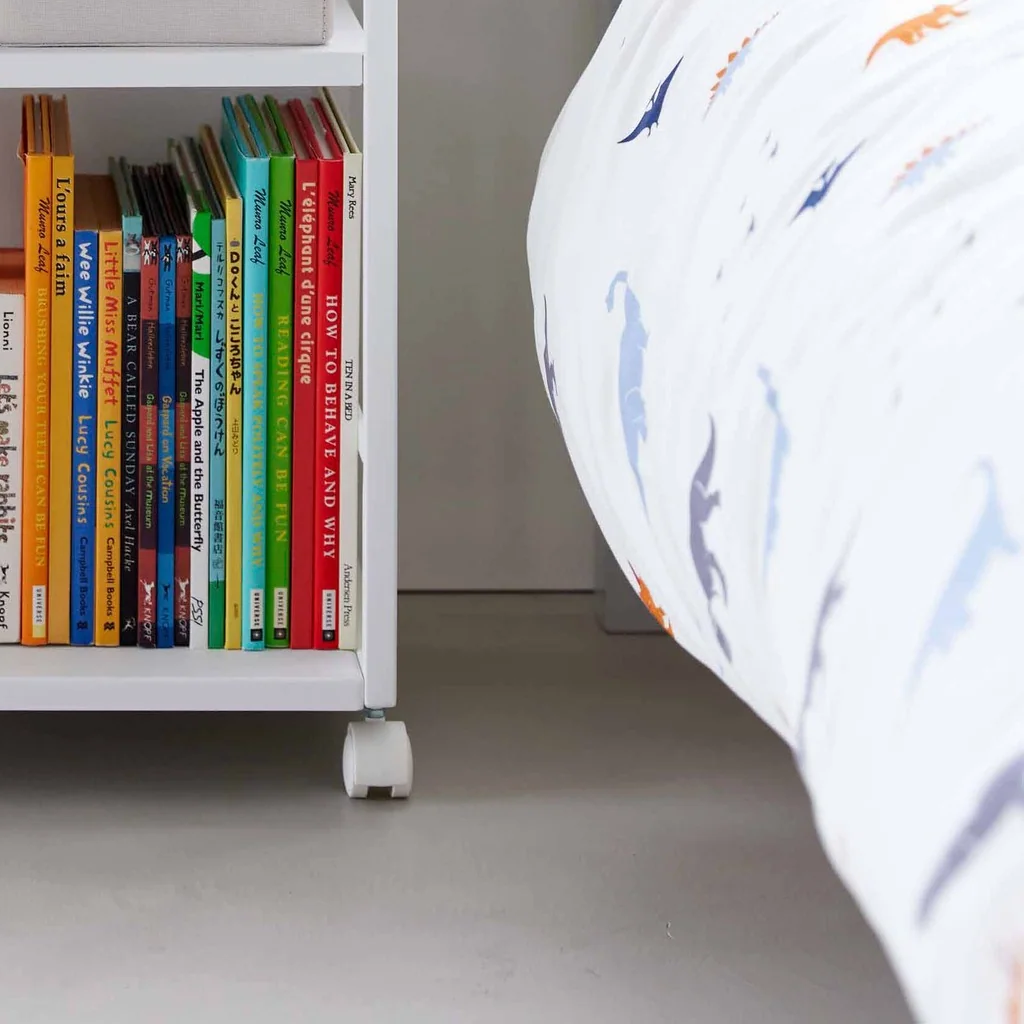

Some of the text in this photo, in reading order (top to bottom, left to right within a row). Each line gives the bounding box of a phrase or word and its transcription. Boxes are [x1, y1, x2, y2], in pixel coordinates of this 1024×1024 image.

[35, 198, 50, 274] Munro Leaf
[55, 178, 70, 296] L'ours a faim
[251, 189, 266, 265] Munro Leaf
[324, 190, 339, 268] Munro Leaf
[347, 176, 356, 219] Mary Rees
[276, 199, 292, 276] Munro Leaf
[78, 242, 94, 399] Wee Willie Winkie
[194, 281, 204, 340] Mari/Mari
[299, 182, 316, 384] L'éléphant d'une cirque
[3, 312, 14, 351] Lionni
[103, 241, 120, 405] Little Miss Muffet
[214, 329, 226, 457] しずくのぼうけん
[345, 360, 353, 379] TEN
[345, 382, 353, 392] IN
[35, 288, 47, 567] BRUSHING YOUR TEETH CAN BE FUN
[124, 296, 137, 572] A BEAR CALLED SUNDAY Axel Hacke
[251, 293, 264, 567] HOW TO SPEAK POLITELY AND WHY
[276, 315, 289, 542] READING CAN BE FUN
[323, 295, 337, 559] HOW TO BEHAVE AND WHY
[344, 402, 353, 420] BED
[77, 415, 92, 523] Lucy Cousins
[103, 420, 117, 528] Lucy Cousins
[146, 476, 154, 487] the
[192, 370, 204, 552] The Apple and the Butterfly
[77, 536, 88, 616] Campbell Books
[104, 537, 115, 616] Campbell Books
[343, 564, 353, 626] Andersen Press
[144, 607, 152, 641] KNOPF
